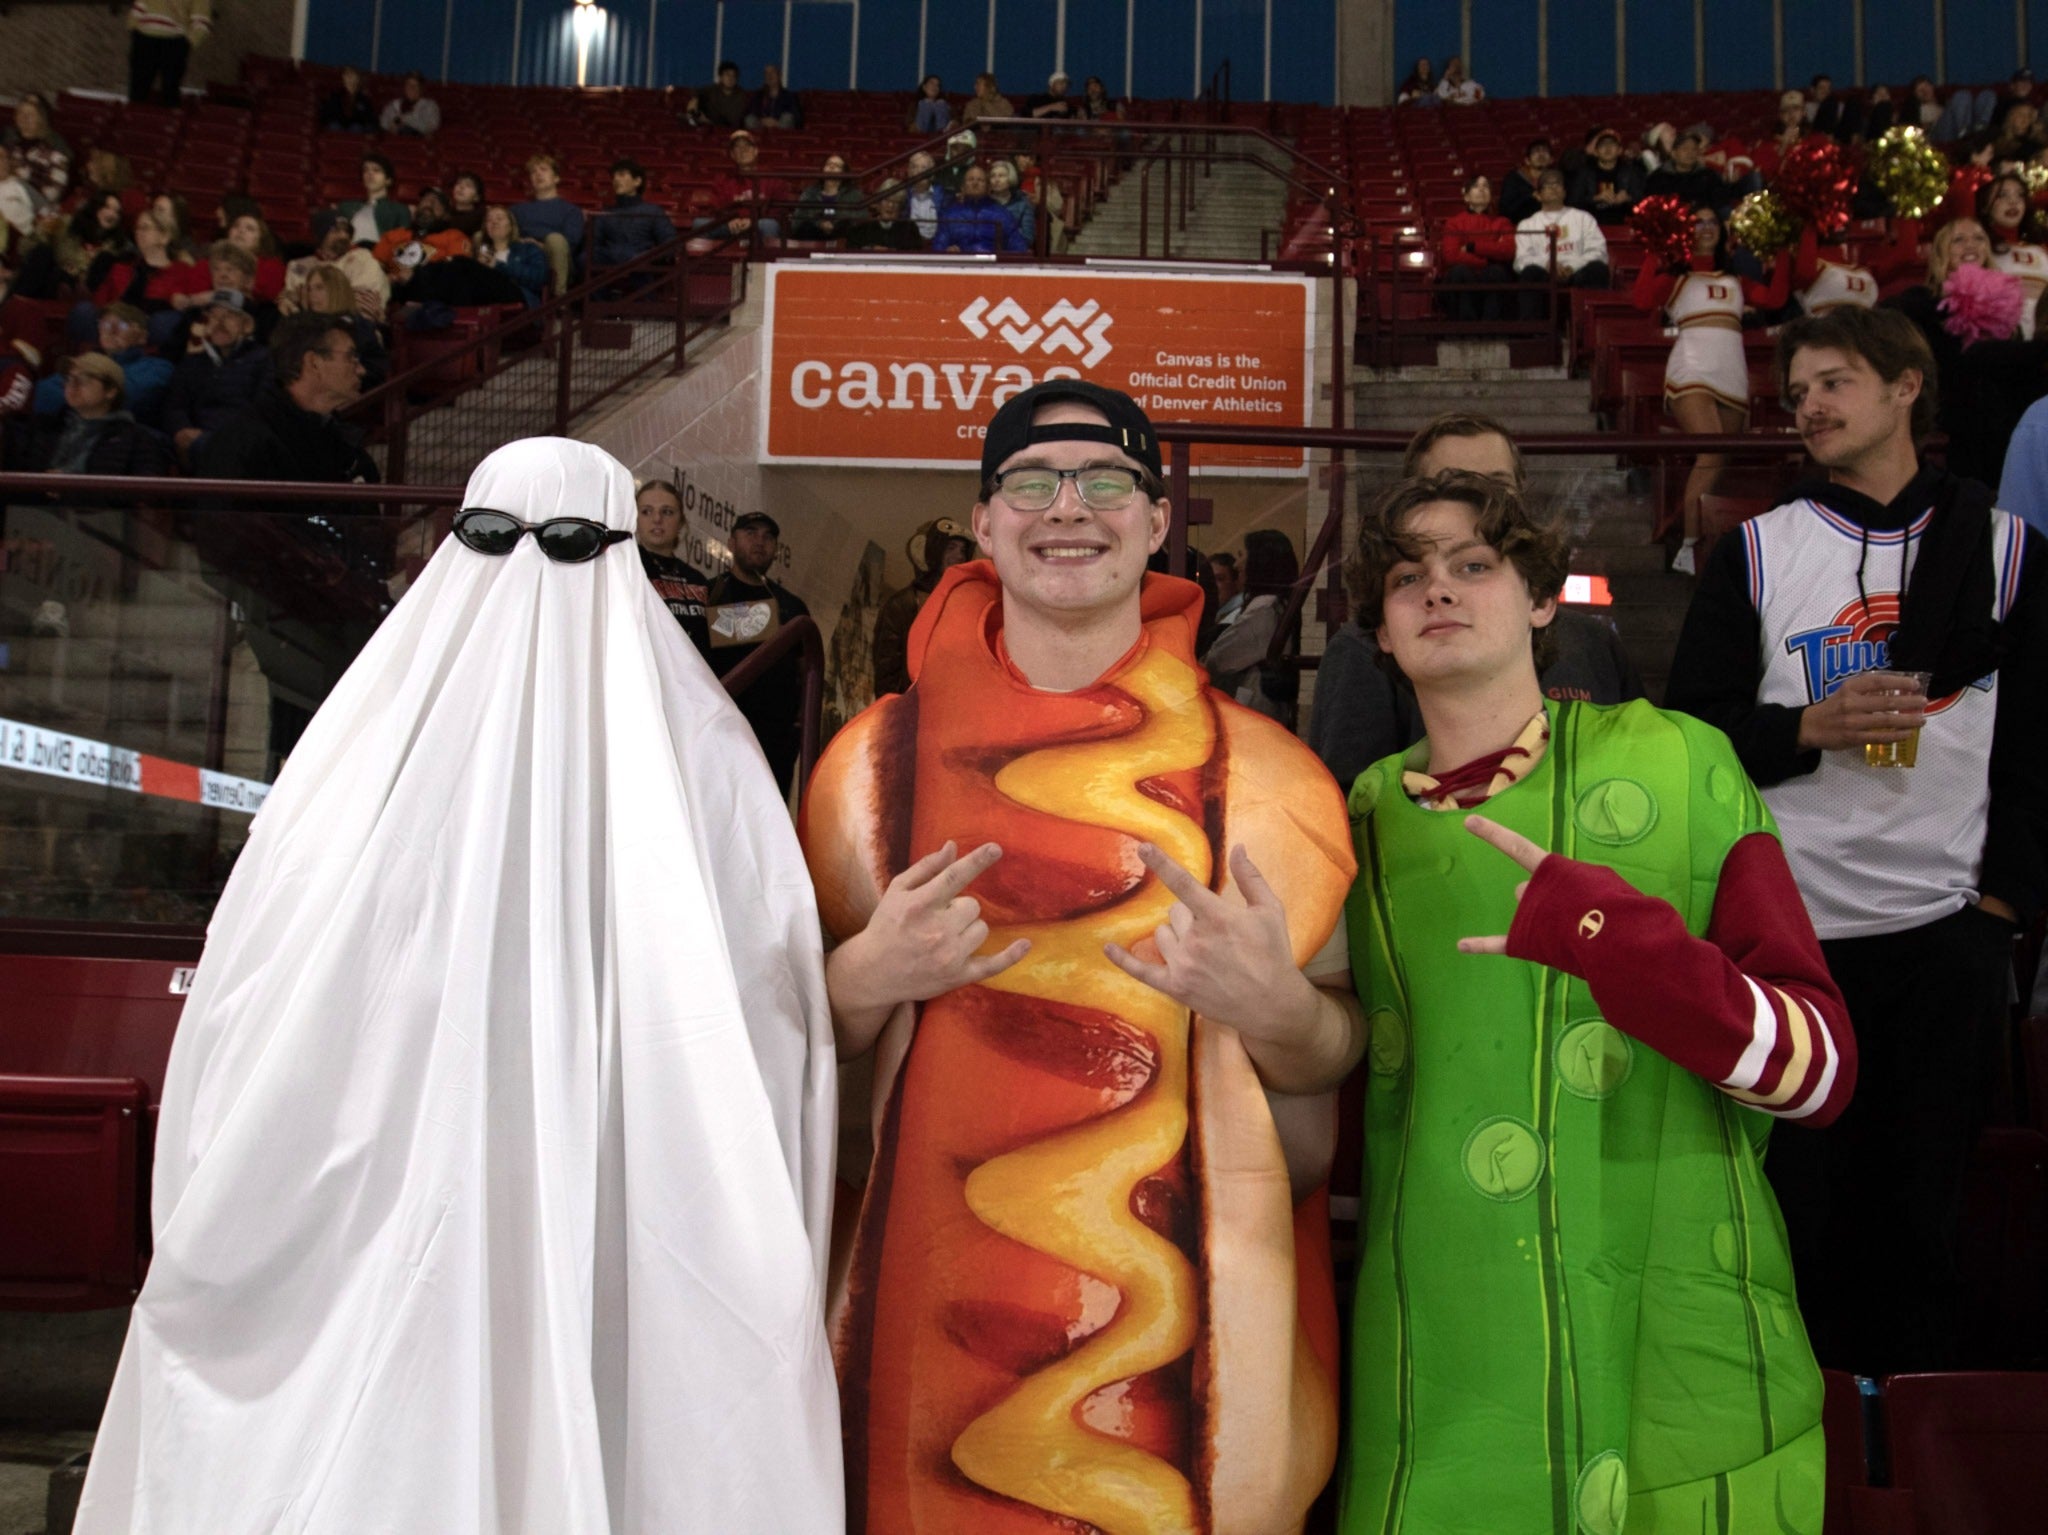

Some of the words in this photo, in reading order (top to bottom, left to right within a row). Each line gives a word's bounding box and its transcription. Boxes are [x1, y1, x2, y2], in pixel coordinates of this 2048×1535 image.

[1156, 351, 1212, 367] Canvas
[1217, 353, 1230, 368] is
[1235, 354, 1260, 368] the
[1129, 372, 1182, 388] Official
[1187, 374, 1236, 389] Credit
[1241, 376, 1287, 391] Union
[1152, 395, 1209, 410] Denver
[1213, 397, 1283, 412] Athletics
[956, 424, 987, 439] cre
[673, 466, 695, 510] No
[699, 491, 736, 533] matt
[1548, 687, 1592, 702] GIUM
